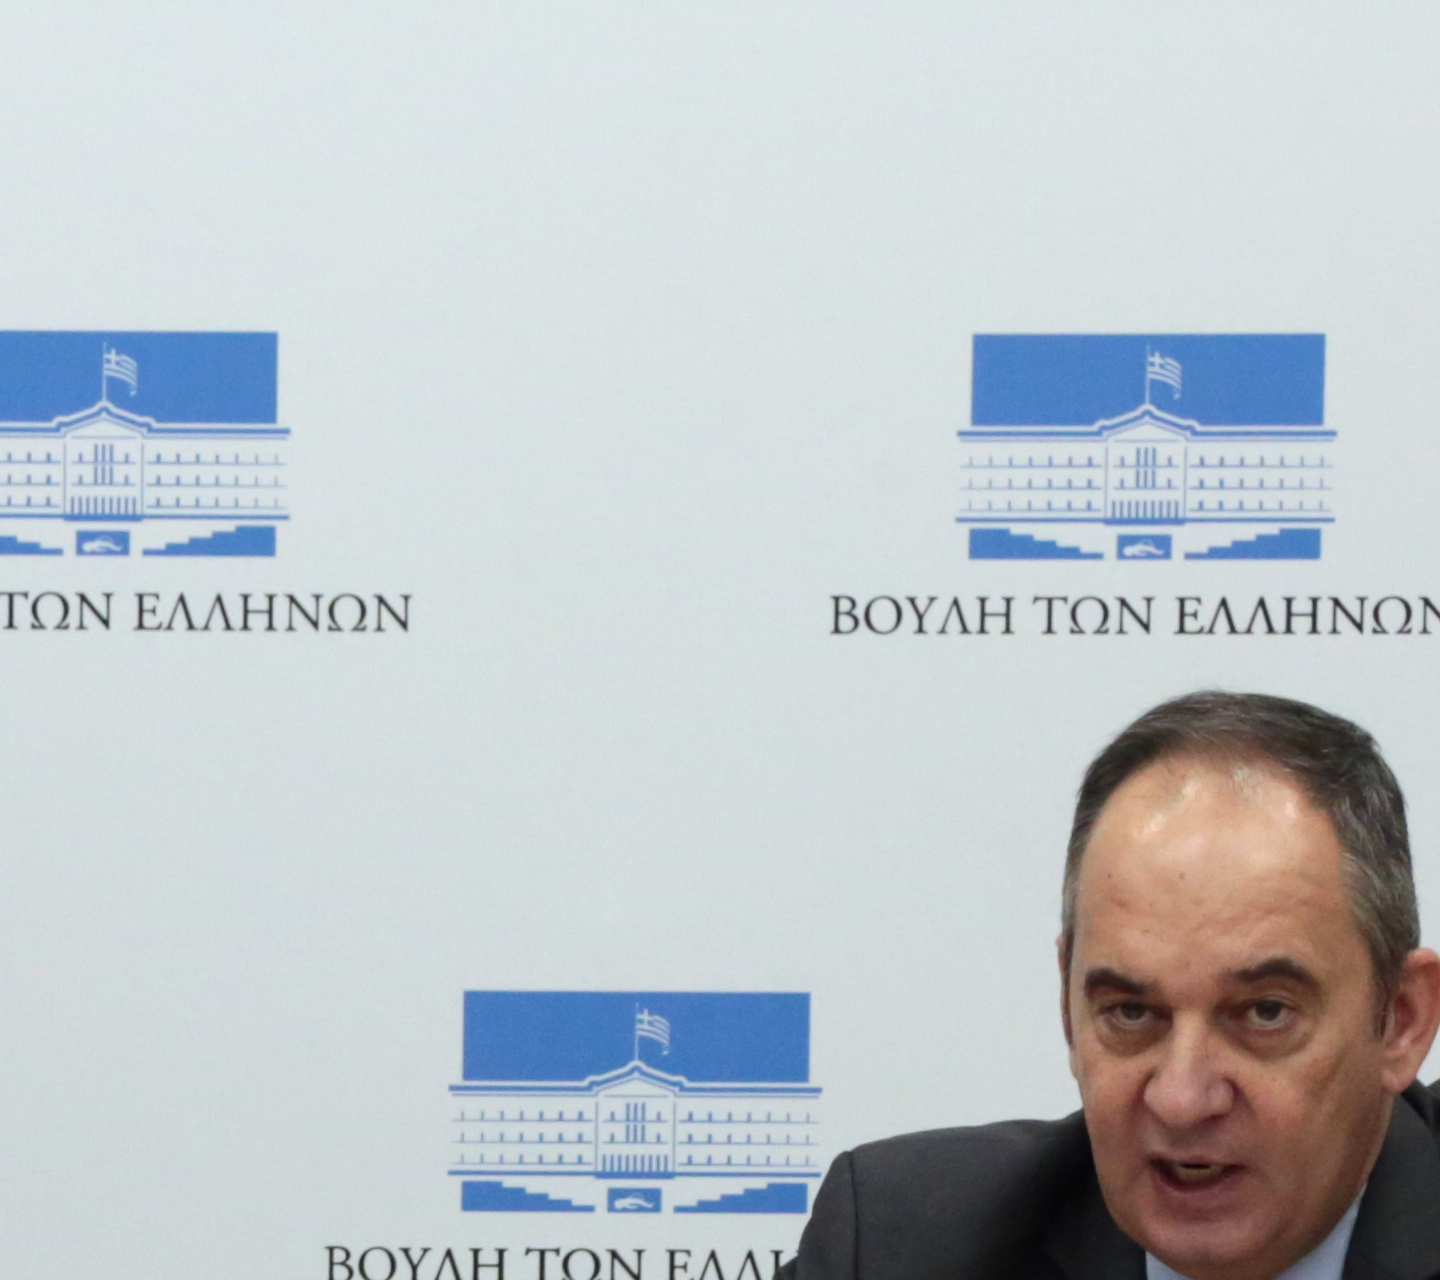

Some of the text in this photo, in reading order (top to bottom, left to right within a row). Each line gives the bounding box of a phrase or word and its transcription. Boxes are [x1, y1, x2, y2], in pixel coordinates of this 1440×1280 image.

[135, 592, 411, 633] ΕΛΛΗΝΩΝ
[831, 595, 1014, 635] ΒΟΥΛΗ
[1032, 595, 1154, 635] ΤΩΝ
